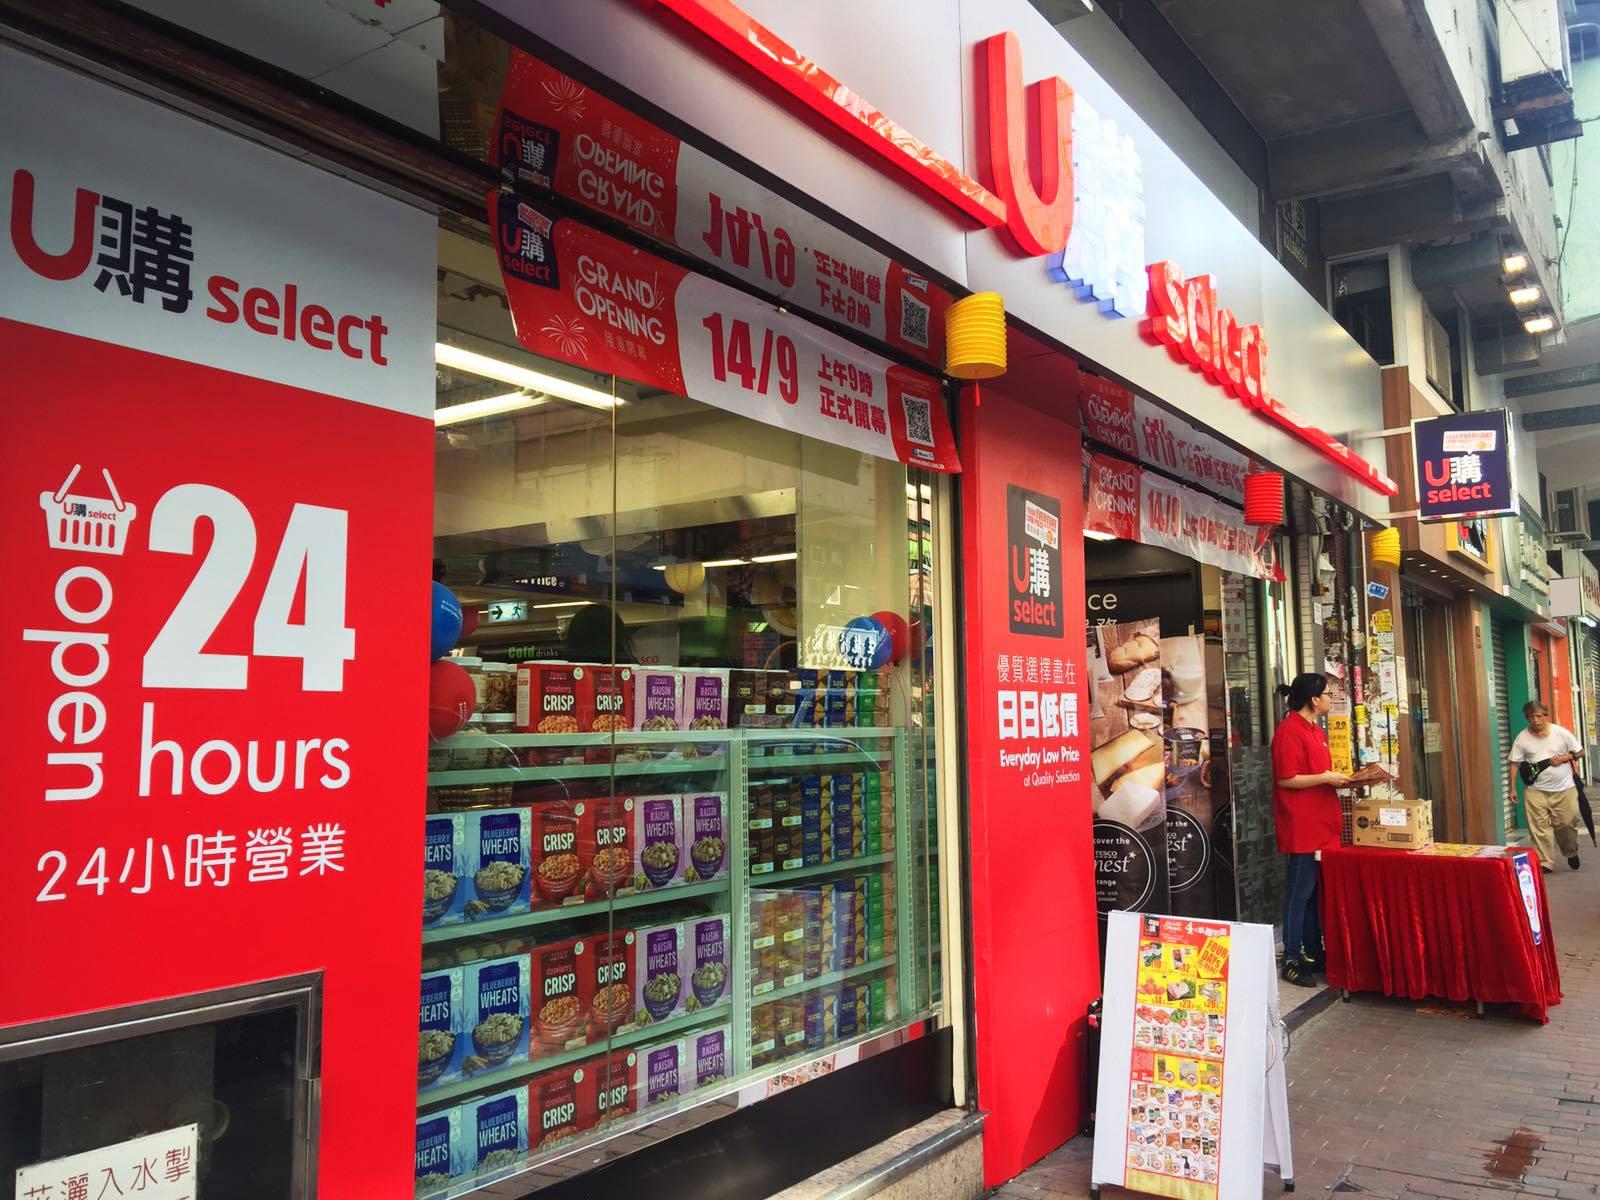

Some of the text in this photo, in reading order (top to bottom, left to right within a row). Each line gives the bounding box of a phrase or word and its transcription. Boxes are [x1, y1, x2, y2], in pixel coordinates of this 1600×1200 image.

[10, 168, 388, 366] U購 select
[503, 255, 552, 281] select
[577, 255, 655, 309] GRAND
[575, 286, 666, 346] OPENING
[702, 312, 799, 405] 14/9
[817, 352, 873, 398] 上午9時
[819, 384, 887, 436] 正式開幕
[1099, 466, 1135, 493] GRAND
[1424, 453, 1483, 487] U購
[1095, 489, 1137, 517] OPENING
[1427, 482, 1492, 504] select
[88, 506, 116, 520] select
[1012, 544, 1051, 598] U購
[141, 483, 355, 692] 24
[1013, 595, 1056, 627] select
[536, 647, 559, 657] drinks
[23, 566, 113, 801] open
[652, 686, 671, 696] RAISIN
[700, 686, 718, 697] RAISIN
[543, 694, 575, 711] CRISP
[647, 696, 675, 711] WHEATS
[696, 697, 721, 711] WHEATS
[997, 690, 1079, 740] 日日低價
[138, 702, 351, 797] hours
[1000, 745, 1080, 771] Everyday Low Price
[1032, 772, 1055, 787] Quality
[1056, 768, 1081, 784] Selection
[650, 810, 670, 822] RAISIN
[699, 806, 718, 818] RAISIN
[483, 827, 518, 839] BLUEBERRY
[646, 821, 675, 838] WHEATS
[695, 817, 721, 833] WHEATS
[482, 837, 519, 856] WHEATS
[543, 832, 575, 852] CRISP
[596, 826, 627, 846] CRSP
[1116, 837, 1130, 845] the
[36, 822, 346, 902] 24小時營業
[1095, 850, 1118, 858] TESCO
[653, 939, 673, 954] RAISIN
[700, 930, 720, 943] RAISIN
[696, 941, 723, 959] WHEATS
[1201, 949, 1222, 969] DAYS
[1206, 940, 1229, 959] FOUR
[648, 951, 677, 971] WHEATS
[482, 976, 517, 992] BLUEBERRY
[544, 973, 576, 997] CRISP
[480, 986, 519, 1009] WHEATS
[701, 1042, 720, 1058] RAISIN
[653, 1058, 674, 1074] RAISIN
[697, 1052, 724, 1074] WHEATS
[649, 1068, 678, 1091] WHEATS
[480, 1109, 515, 1131] BLUEBERRY
[543, 1102, 574, 1129] CRISP
[479, 1120, 517, 1148] WHEATS
[415, 1142, 448, 1169] HEATS
